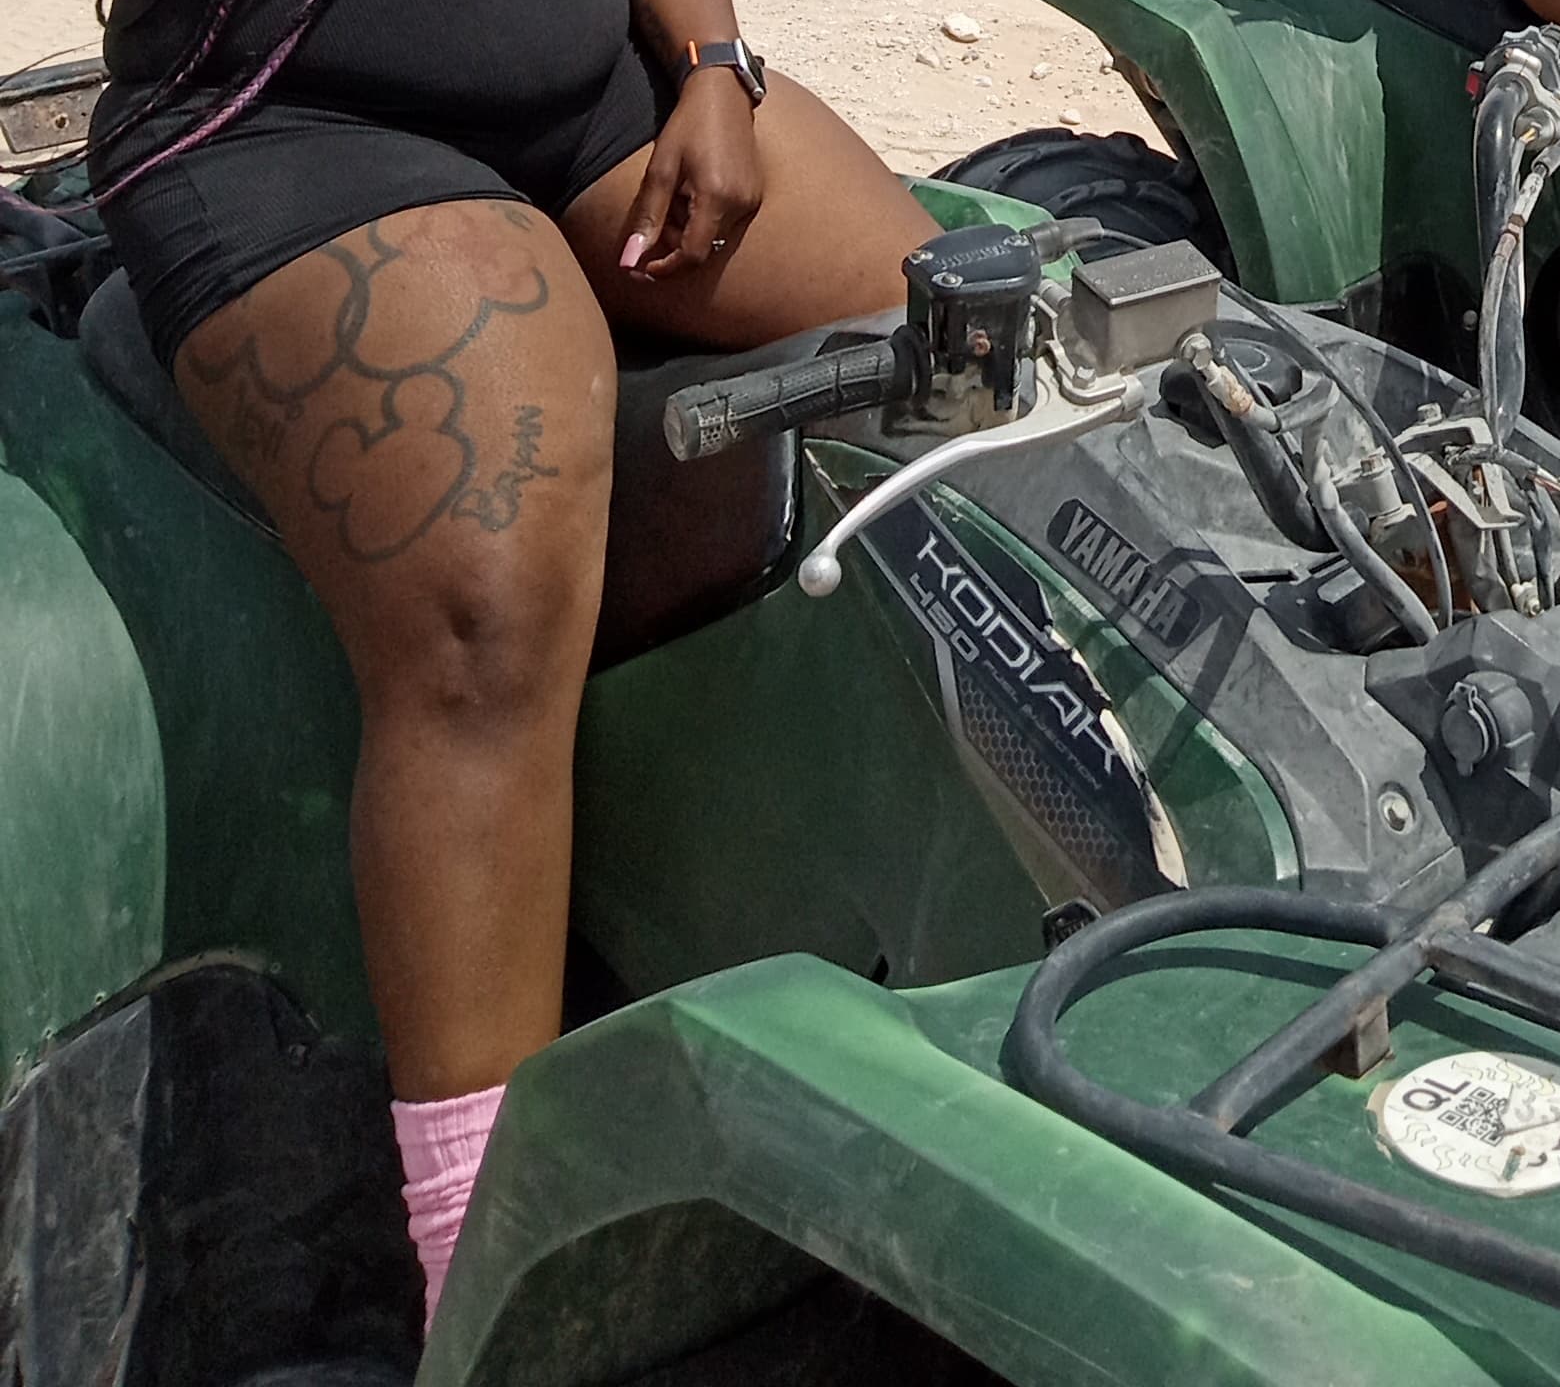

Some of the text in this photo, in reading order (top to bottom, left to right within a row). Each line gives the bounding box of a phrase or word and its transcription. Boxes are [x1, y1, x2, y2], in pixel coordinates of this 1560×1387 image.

[909, 572, 981, 663] 450
[1059, 507, 1188, 639] YAMAHA
[915, 530, 1119, 775] KODIAK
[1021, 701, 1101, 790] INJECTION
